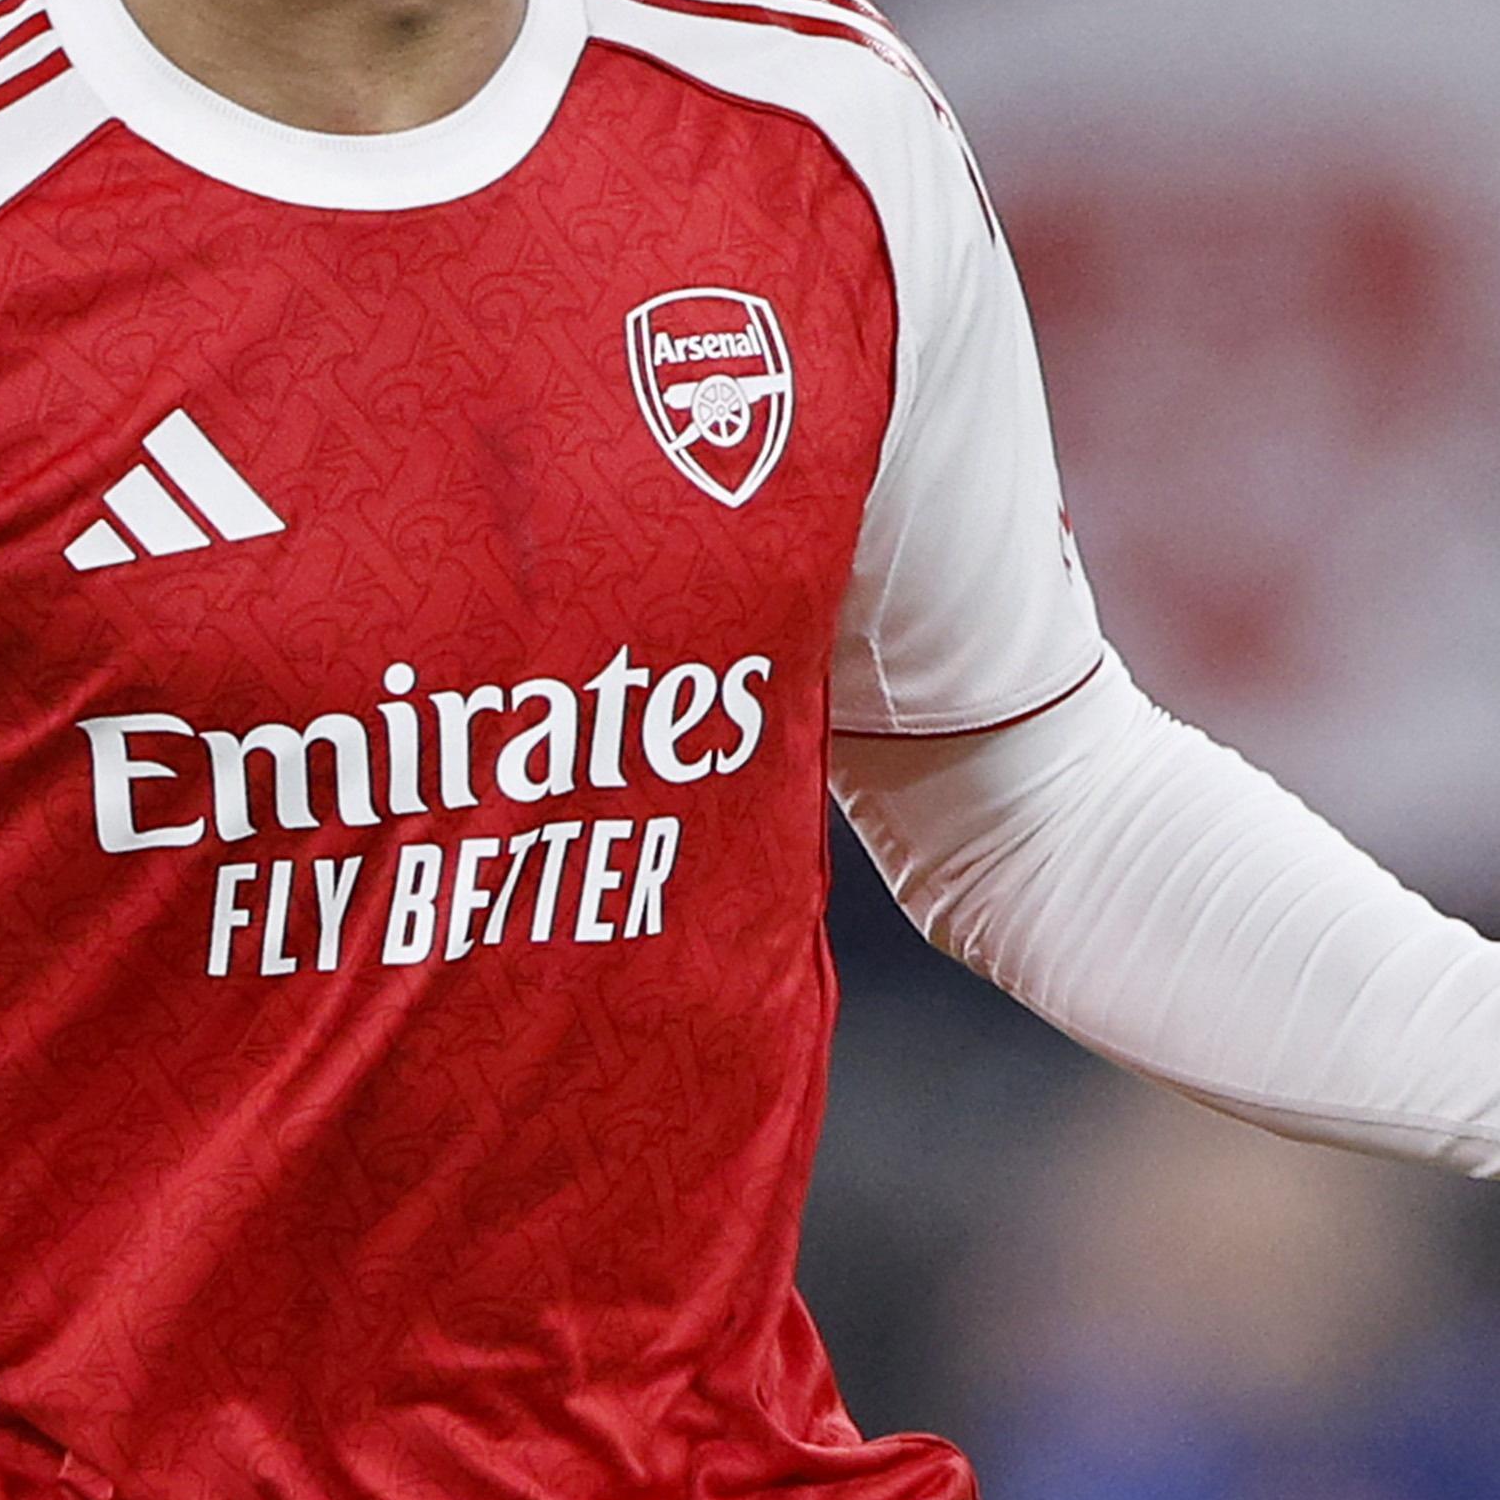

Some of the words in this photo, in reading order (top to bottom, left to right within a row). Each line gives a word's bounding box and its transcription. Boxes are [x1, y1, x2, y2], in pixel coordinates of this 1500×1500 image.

[653, 323, 763, 367] Arsenal
[75, 642, 773, 855] Emirates
[206, 855, 364, 978] FLY
[380, 815, 682, 966] BETTER
